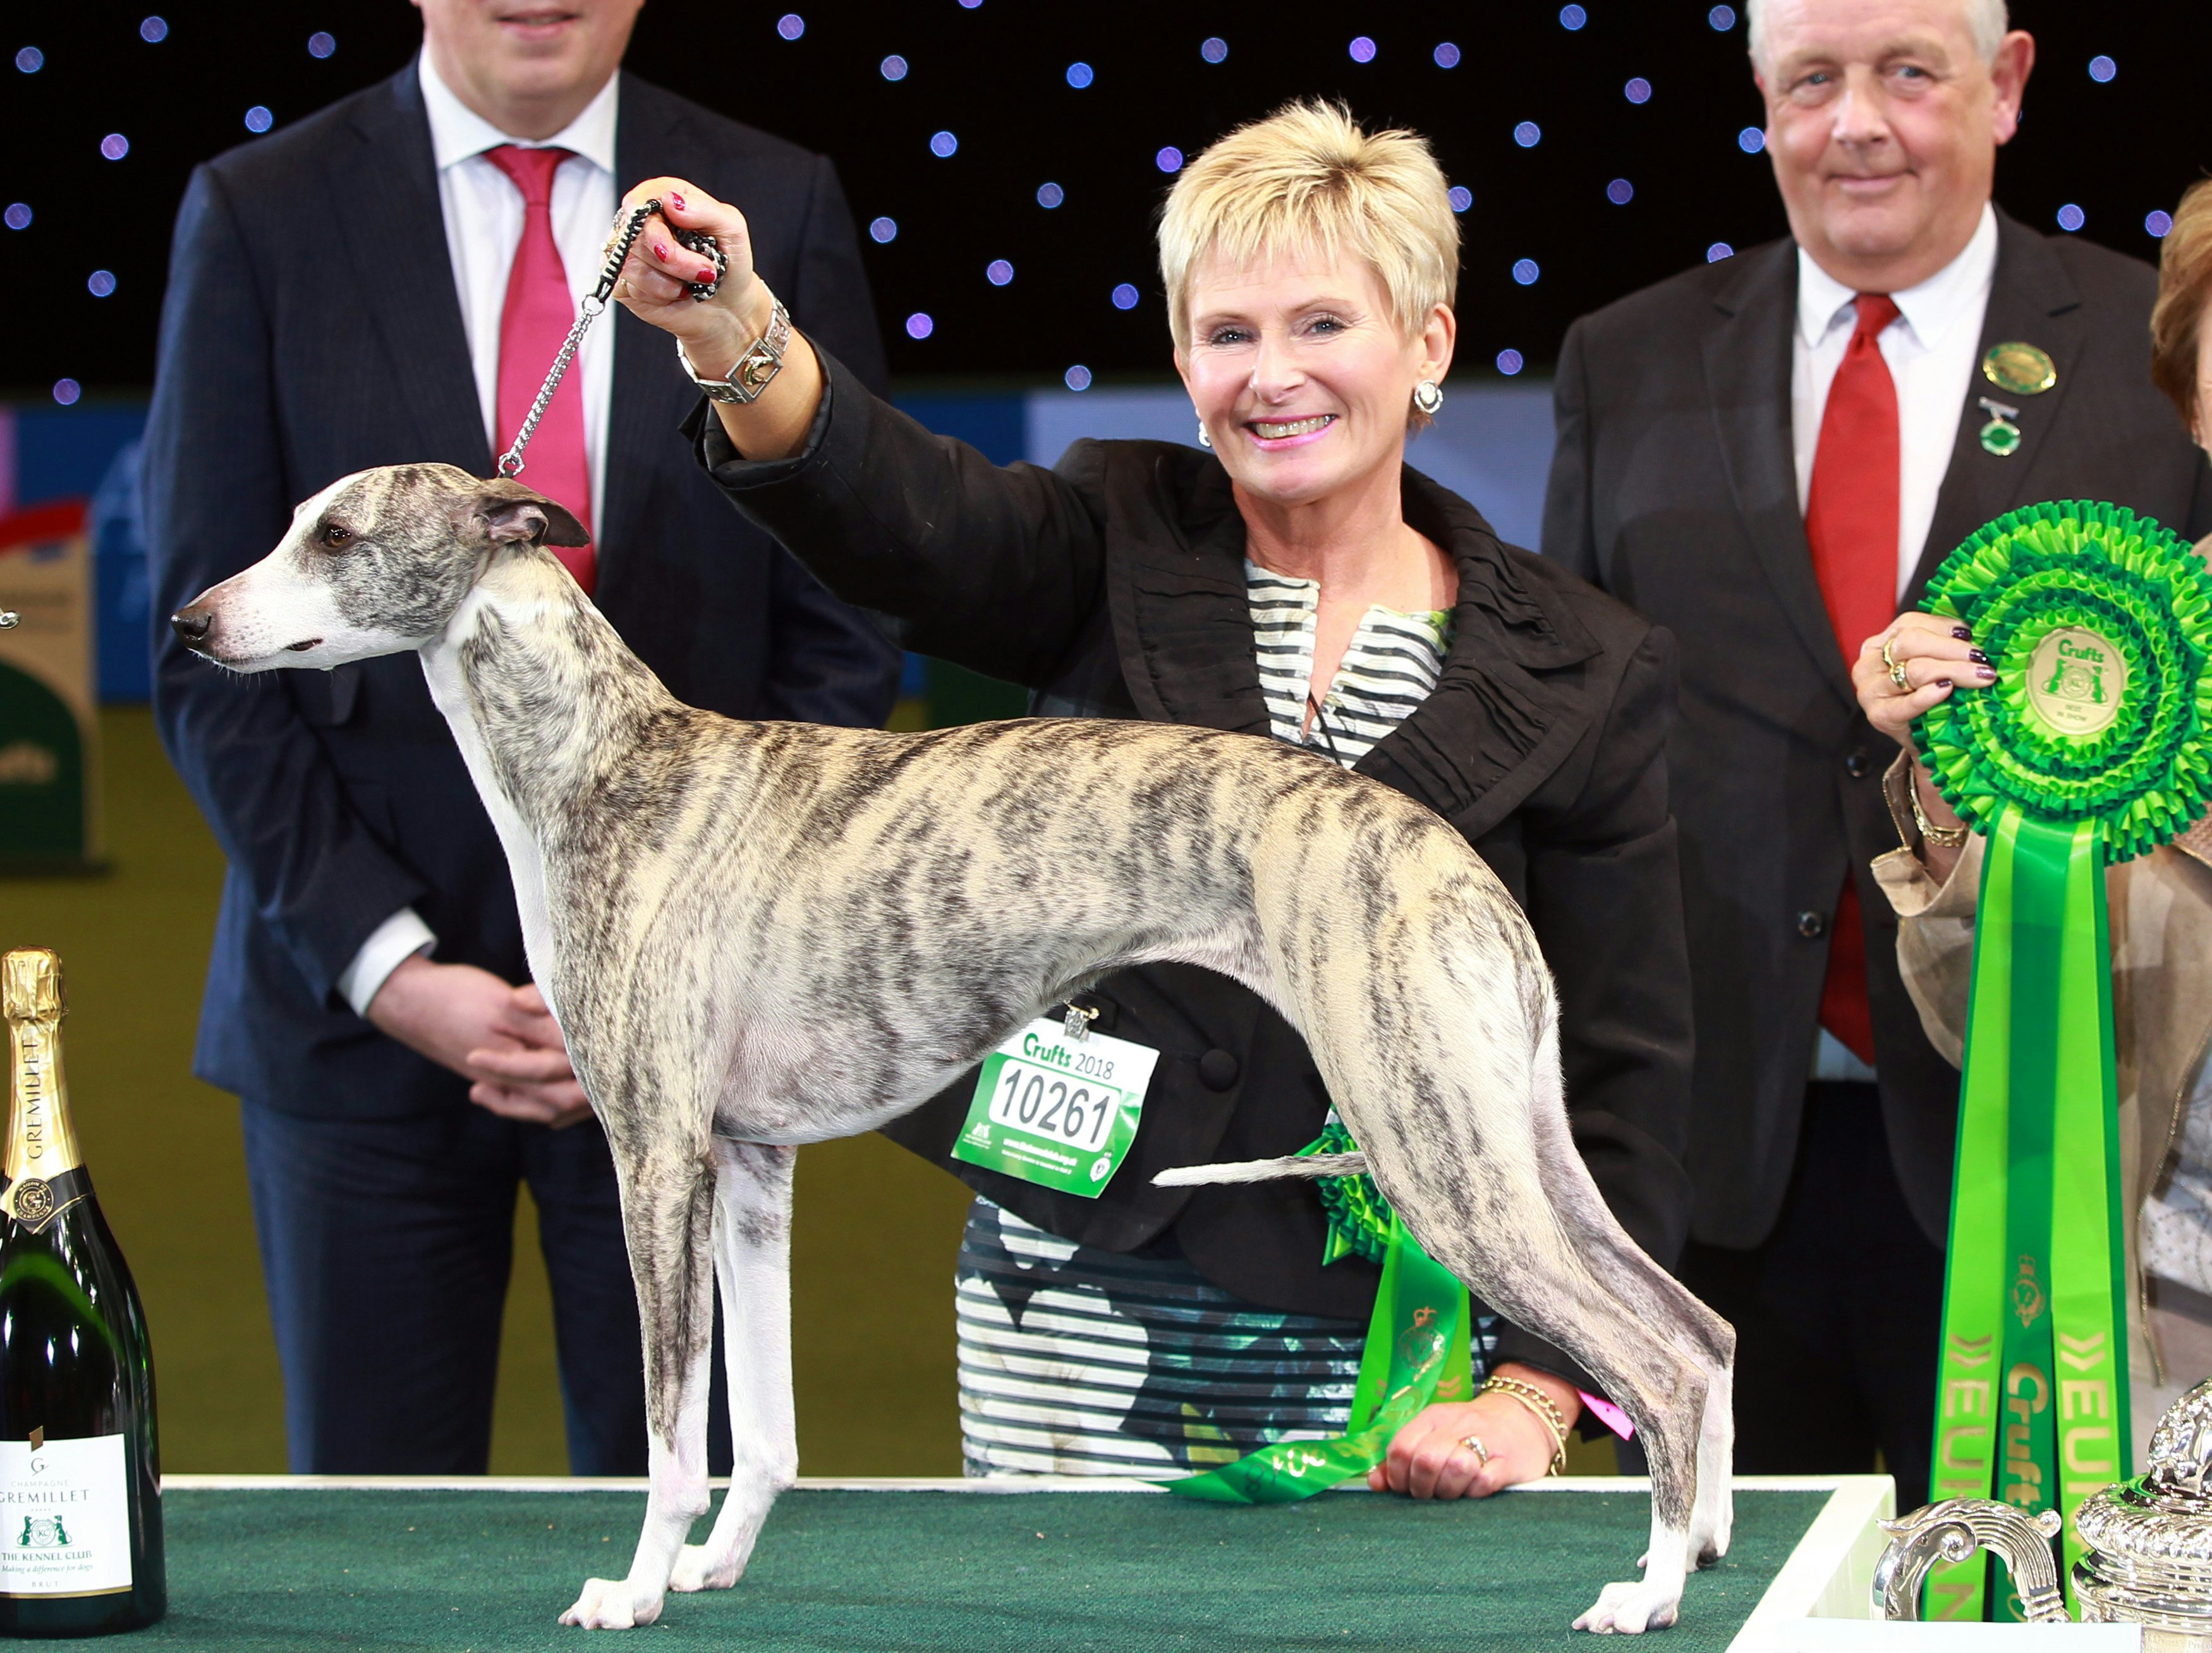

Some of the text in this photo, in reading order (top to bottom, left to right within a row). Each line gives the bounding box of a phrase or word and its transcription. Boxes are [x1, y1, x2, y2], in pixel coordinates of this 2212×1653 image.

[2058, 639, 2105, 663] Crufts
[1023, 1032, 1114, 1080] Crufts 2018
[23, 1040, 43, 1160] GREMILLET
[1002, 1069, 1110, 1144] 10261
[2006, 1362, 2048, 1513] Cruft
[11, 1479, 70, 1488] CHAMPAGNE
[2, 1550, 92, 1561] THE KENNEL CLUB
[2, 1564, 25, 1574] Making
[32, 1563, 64, 1575] difference
[65, 1563, 75, 1574] for
[78, 1563, 93, 1573] dogs
